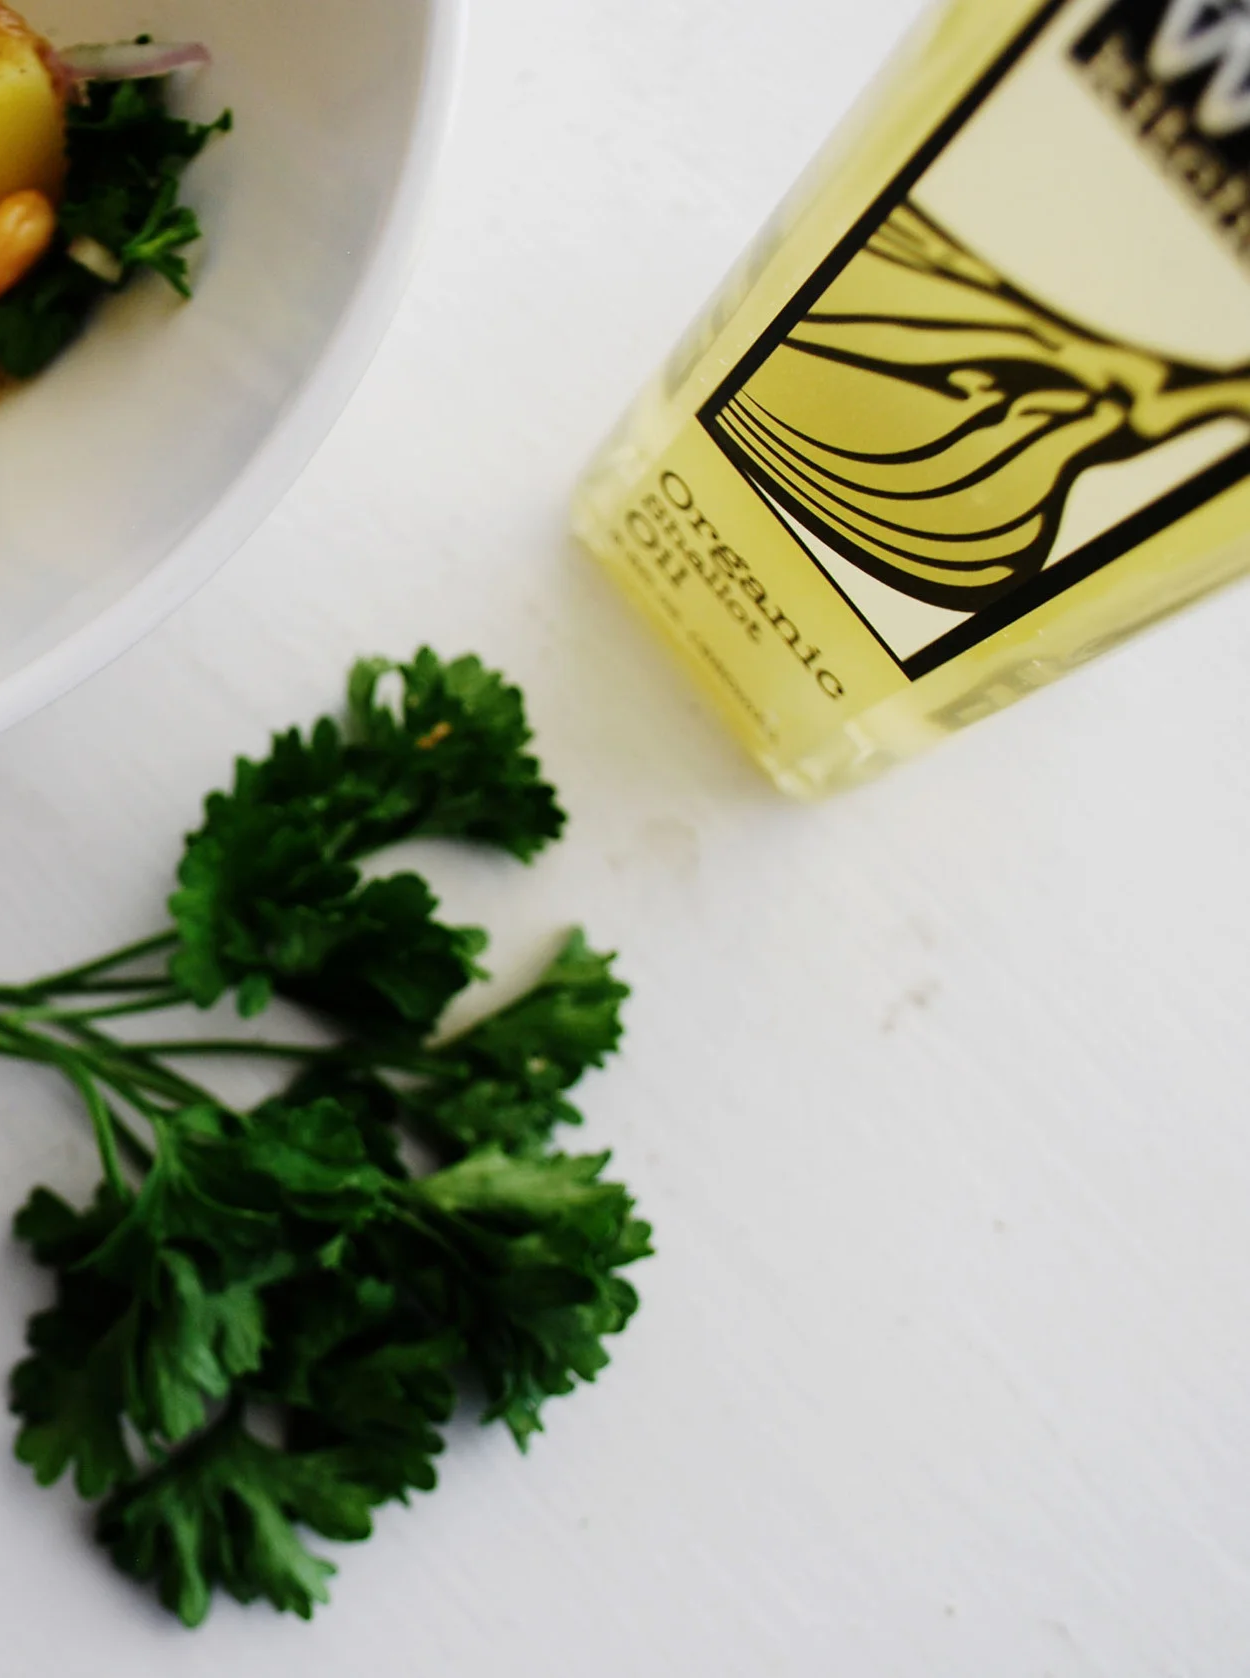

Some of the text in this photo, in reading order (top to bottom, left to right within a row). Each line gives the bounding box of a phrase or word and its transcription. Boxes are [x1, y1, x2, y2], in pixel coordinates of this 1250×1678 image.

[624, 509, 691, 590] Oil
[641, 491, 764, 644] Shallot
[659, 469, 846, 701] Organic
